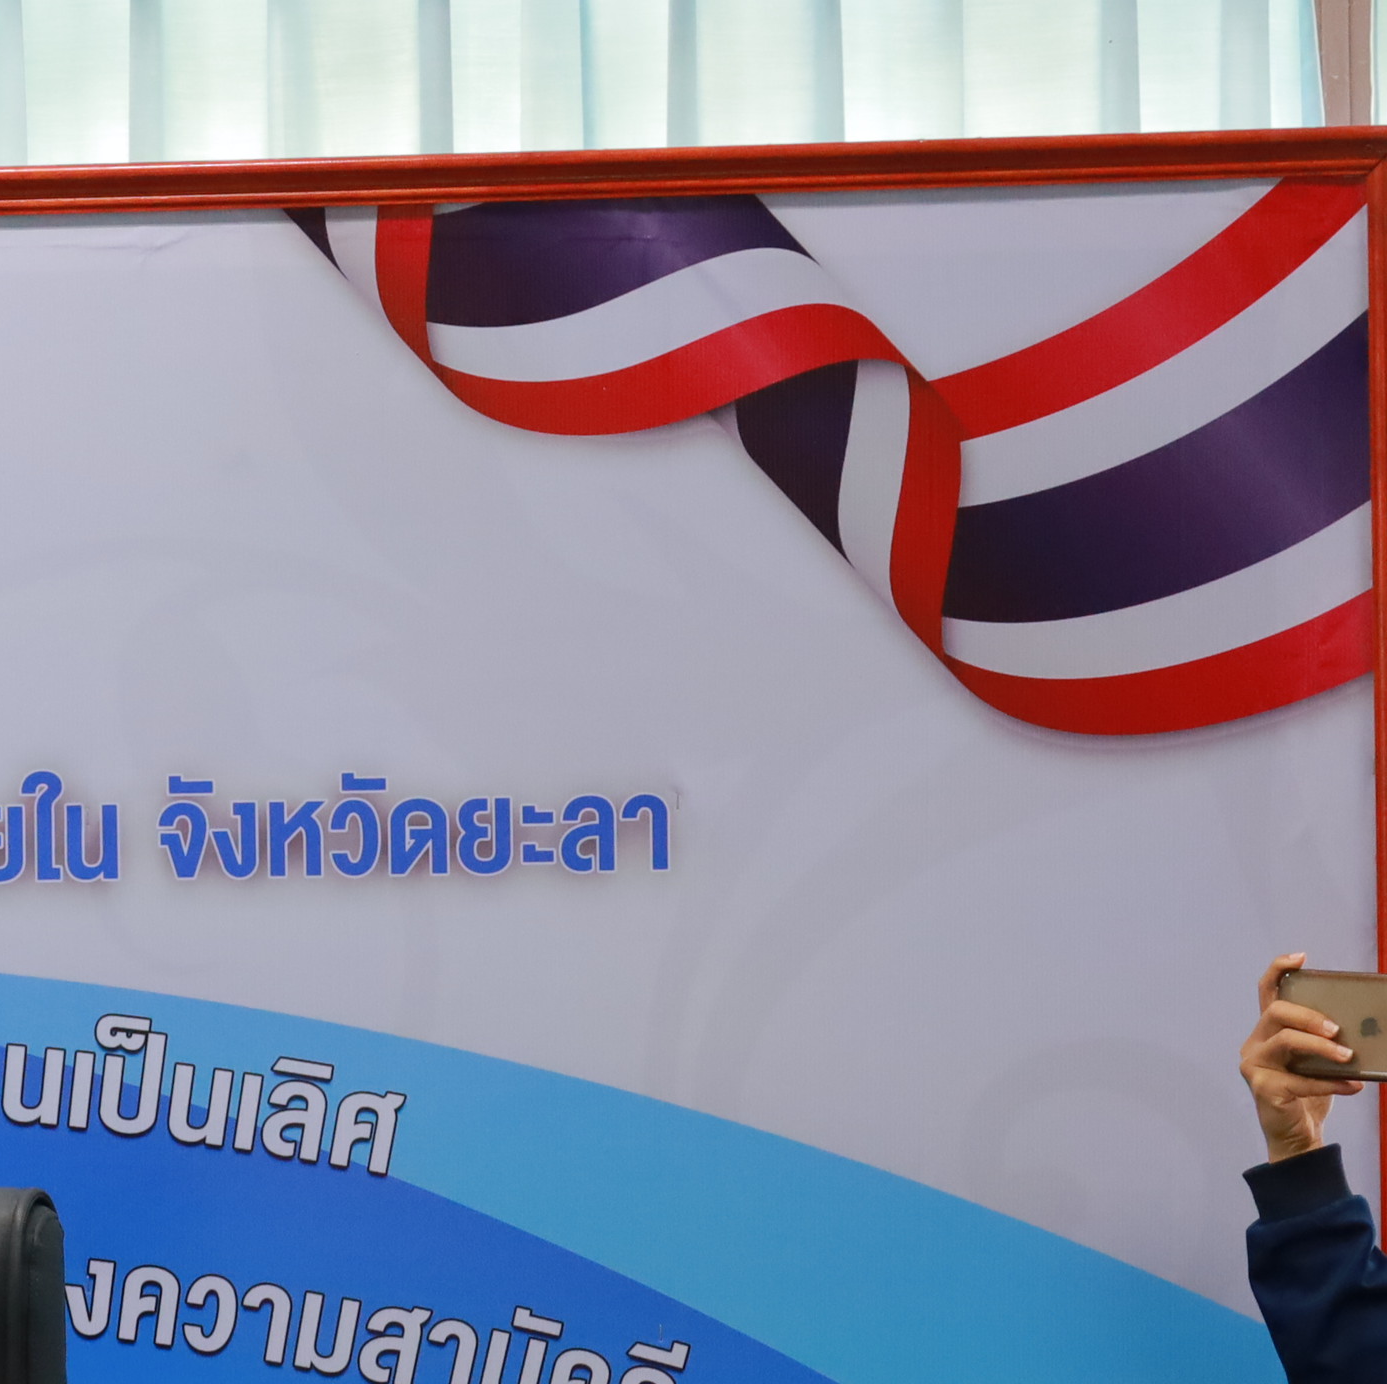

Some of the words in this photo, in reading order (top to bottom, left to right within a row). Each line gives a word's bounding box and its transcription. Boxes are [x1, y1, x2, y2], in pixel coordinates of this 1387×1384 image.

[158, 772, 670, 882] จังหวัดยะลา
